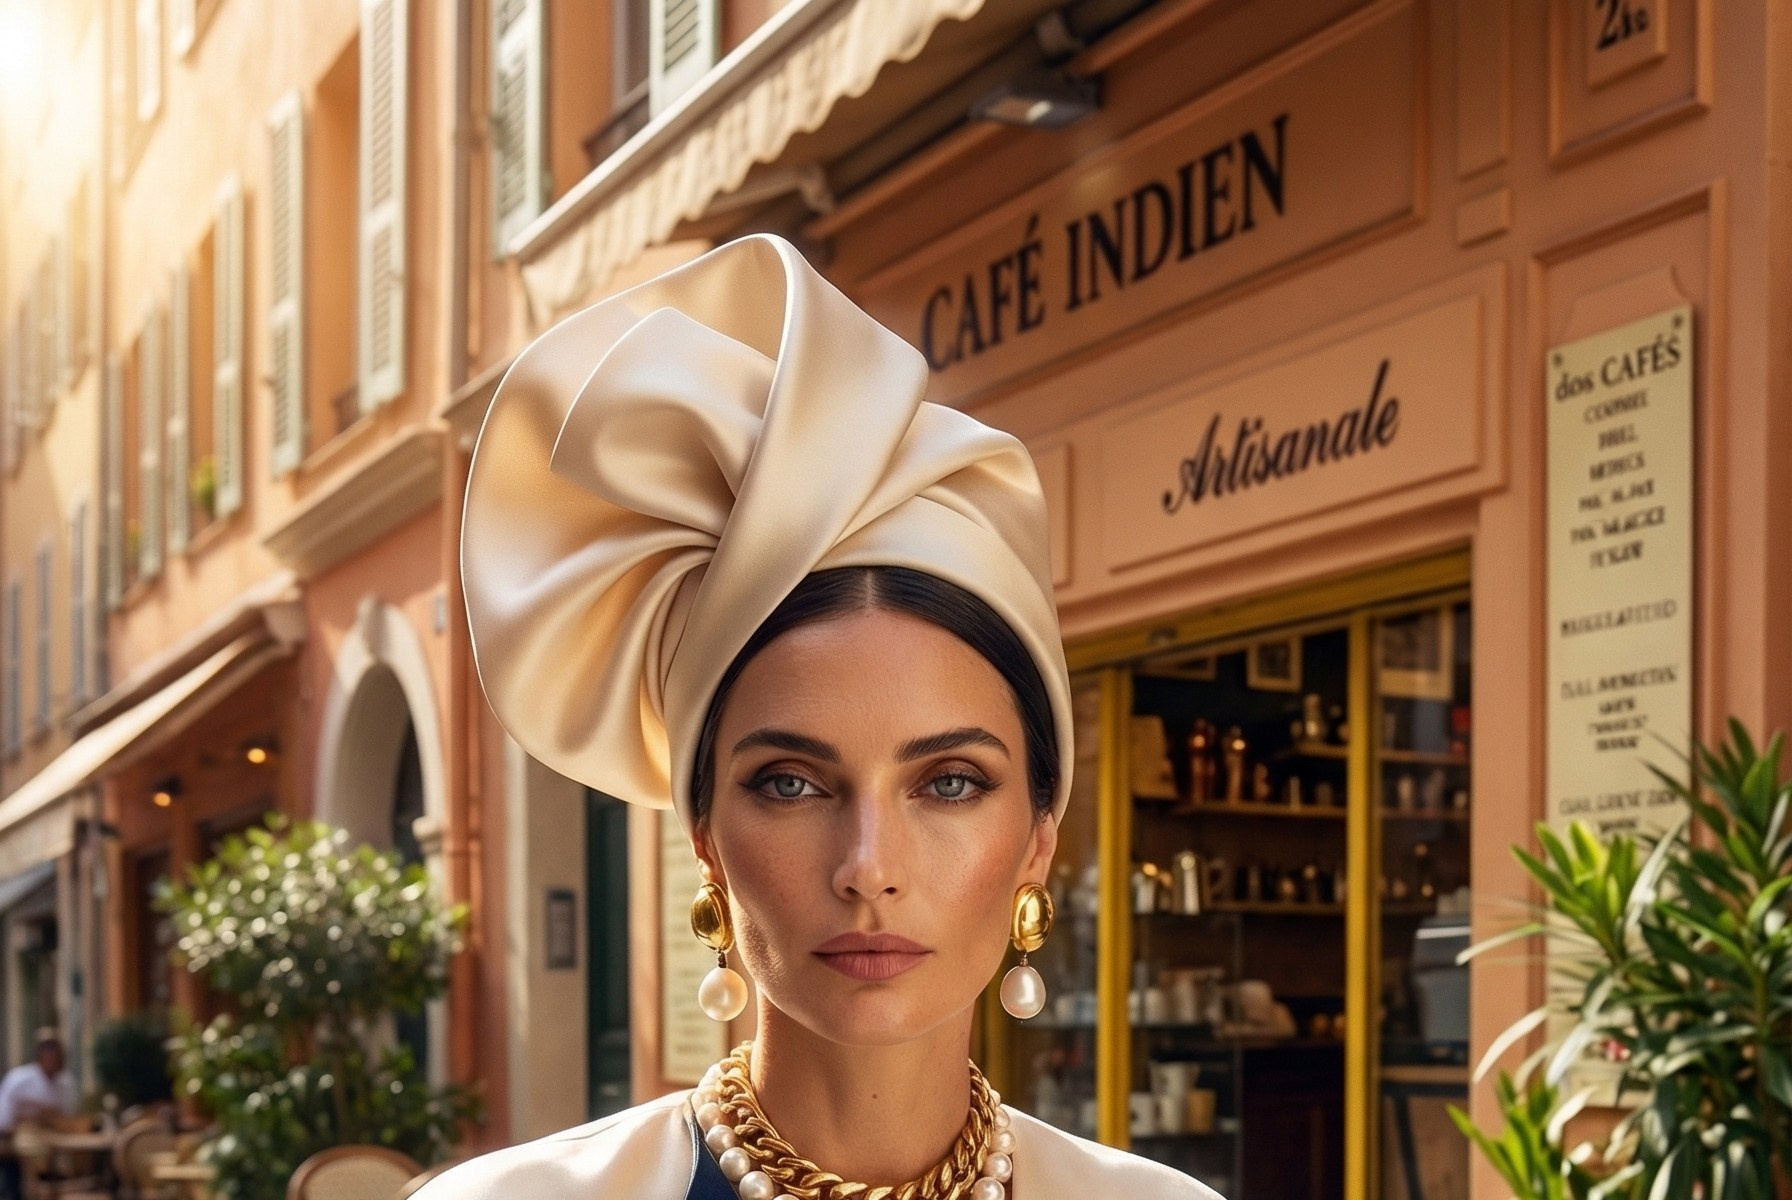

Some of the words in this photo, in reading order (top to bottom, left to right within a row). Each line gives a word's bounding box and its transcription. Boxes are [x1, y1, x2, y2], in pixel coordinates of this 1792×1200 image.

[921, 216, 1046, 373] CAFÉ
[1065, 115, 1289, 312] INDIEN
[1162, 357, 1399, 515] Artisanale
[1600, 335, 1681, 386] CAFÉS
